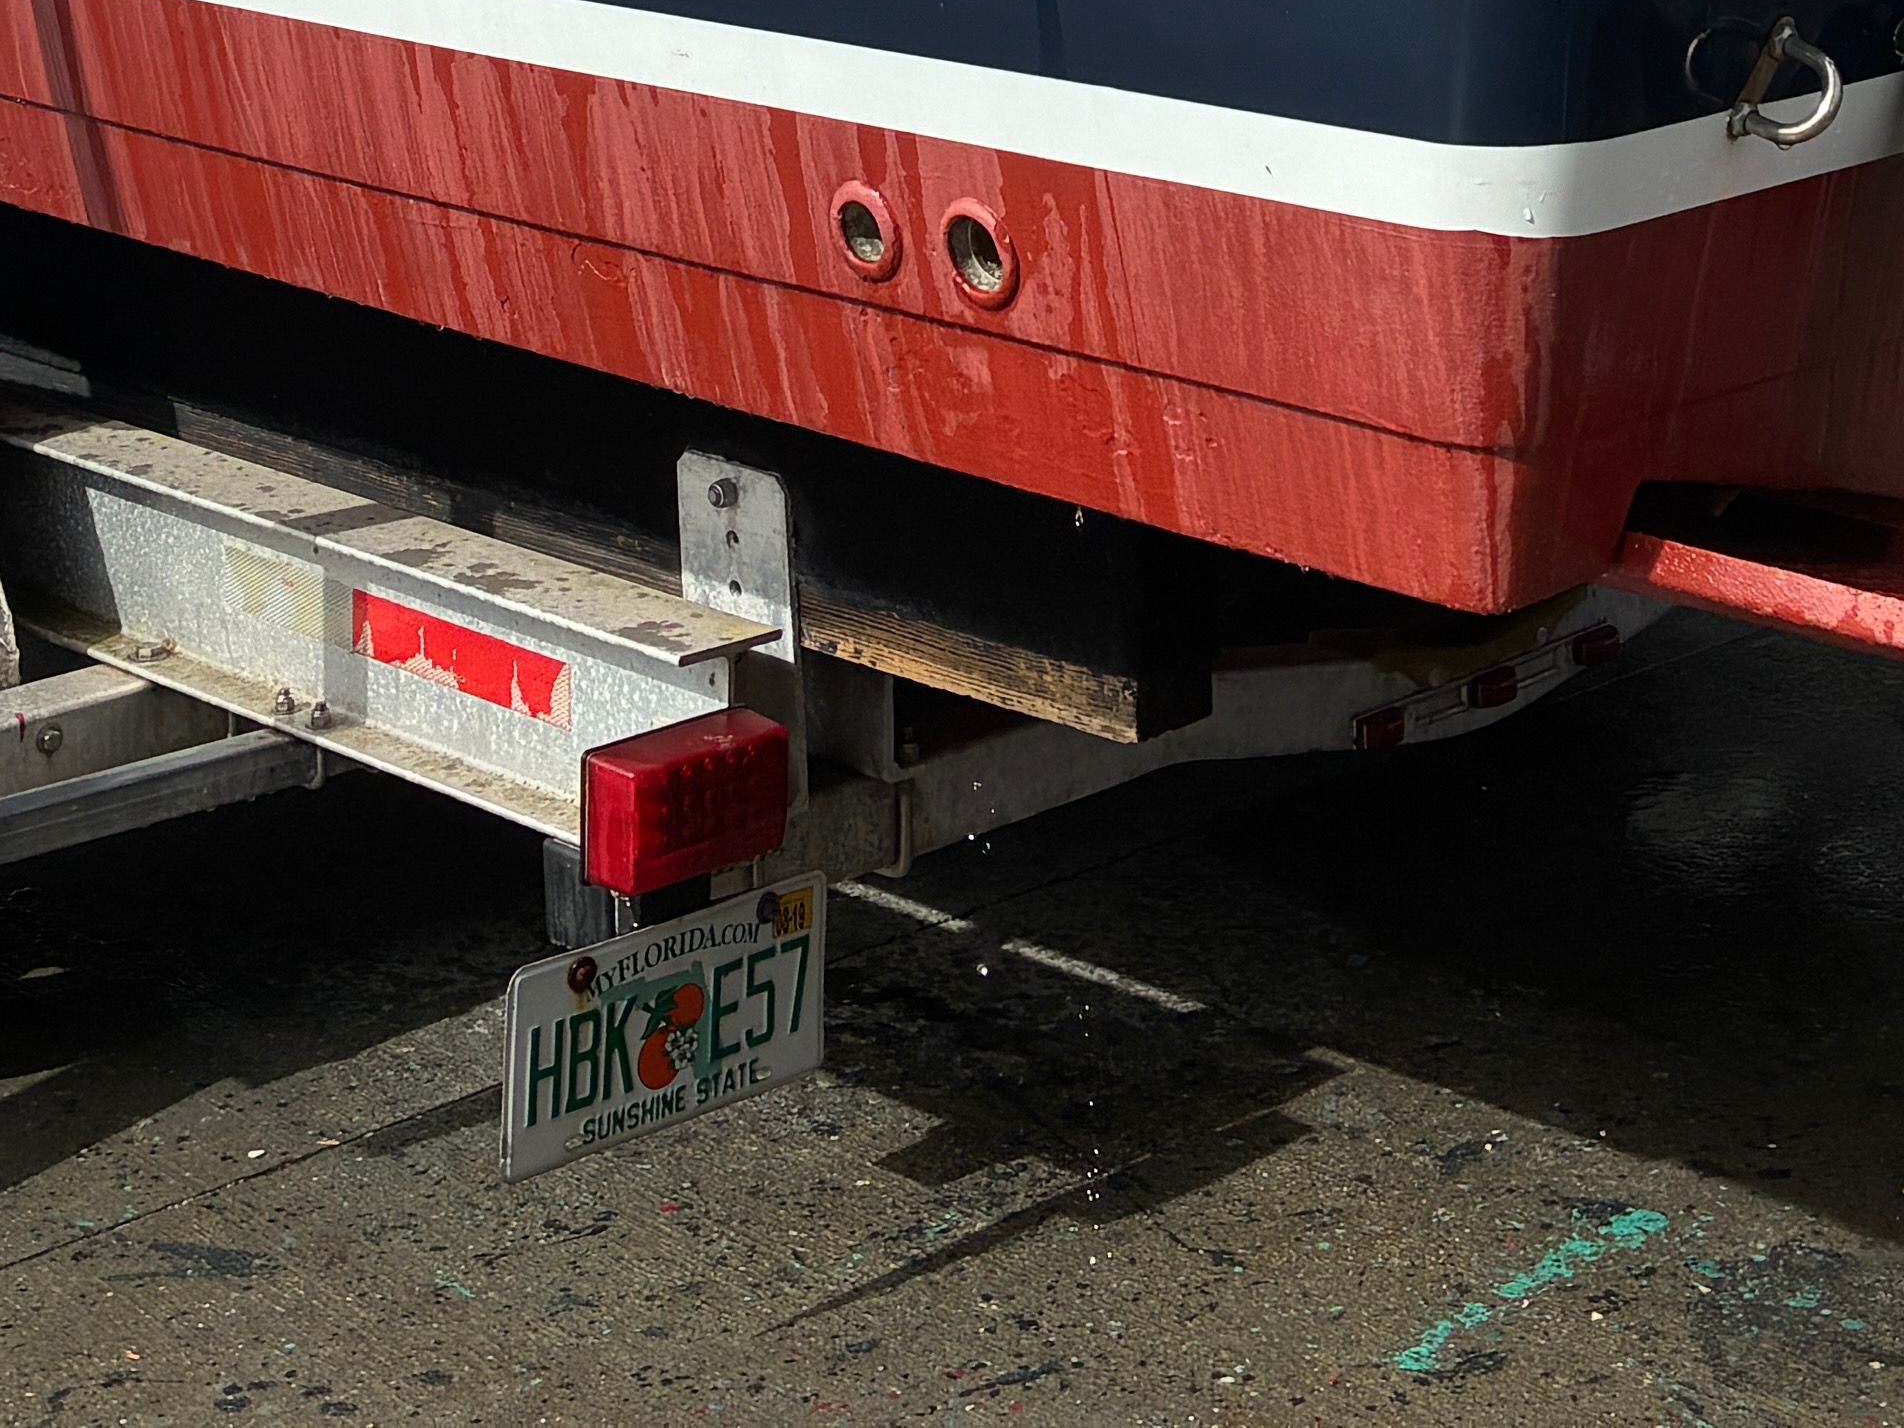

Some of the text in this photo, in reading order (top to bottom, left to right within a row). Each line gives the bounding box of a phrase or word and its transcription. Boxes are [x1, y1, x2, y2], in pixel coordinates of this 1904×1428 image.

[526, 935, 811, 1128] HBK E57
[583, 1057, 761, 1145] SUNSHINE STATE
